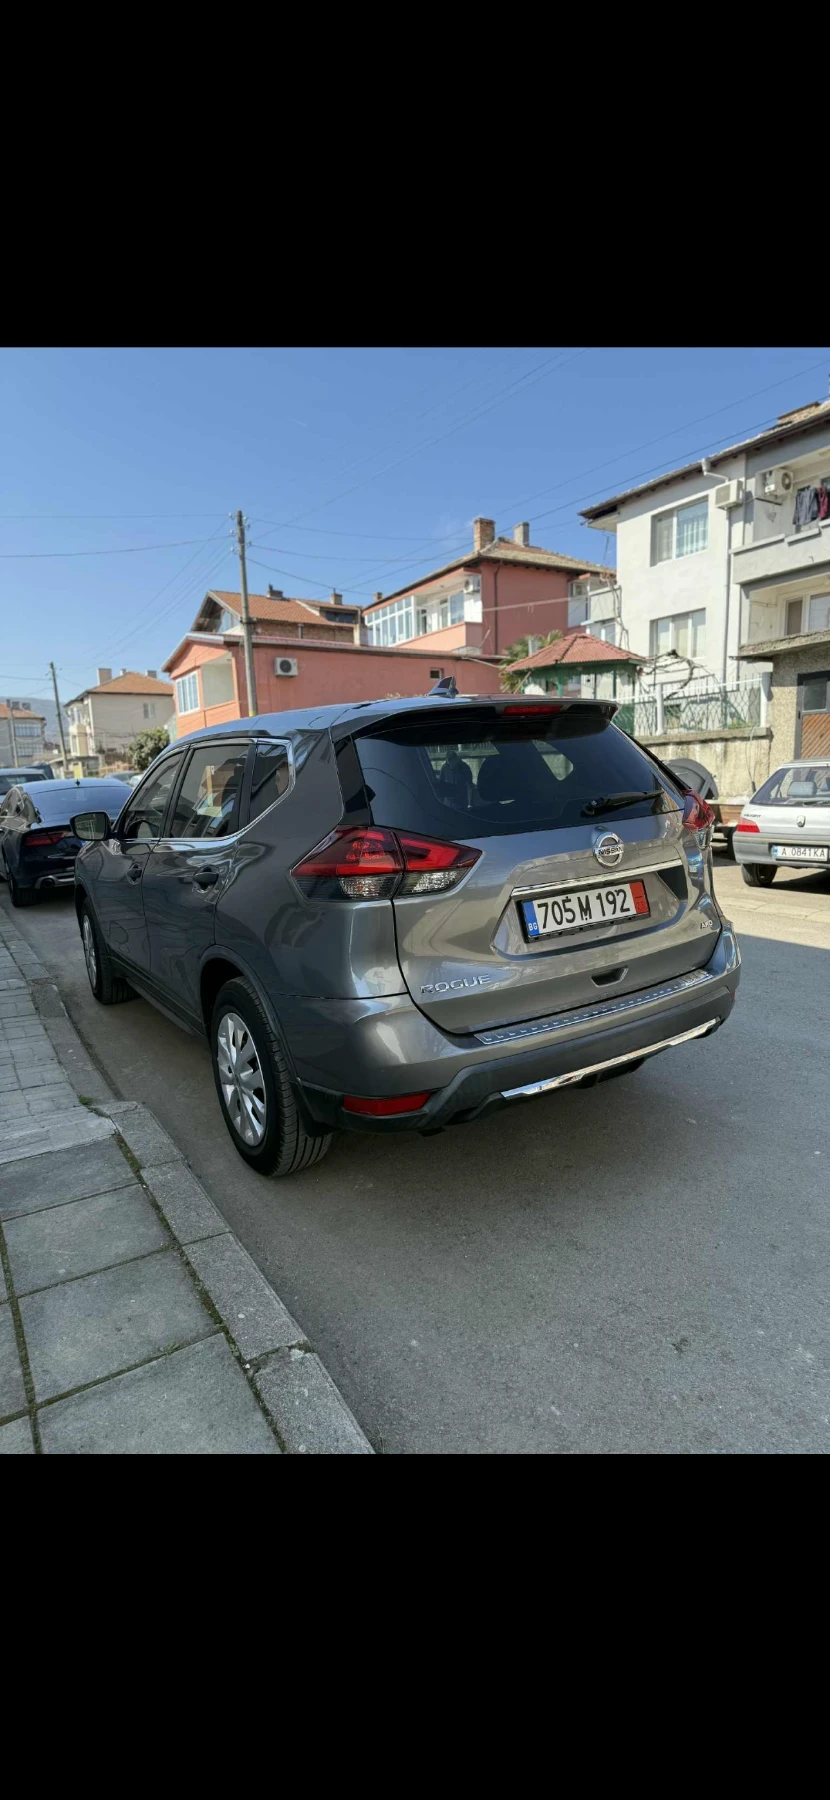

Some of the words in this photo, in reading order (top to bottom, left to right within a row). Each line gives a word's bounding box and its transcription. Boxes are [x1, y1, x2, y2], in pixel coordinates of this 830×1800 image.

[781, 847, 787, 856] A
[537, 897, 576, 929] 705
[577, 894, 593, 921] M
[596, 888, 631, 917] 192
[528, 922, 538, 931] BG
[420, 974, 491, 994] ROGUE
